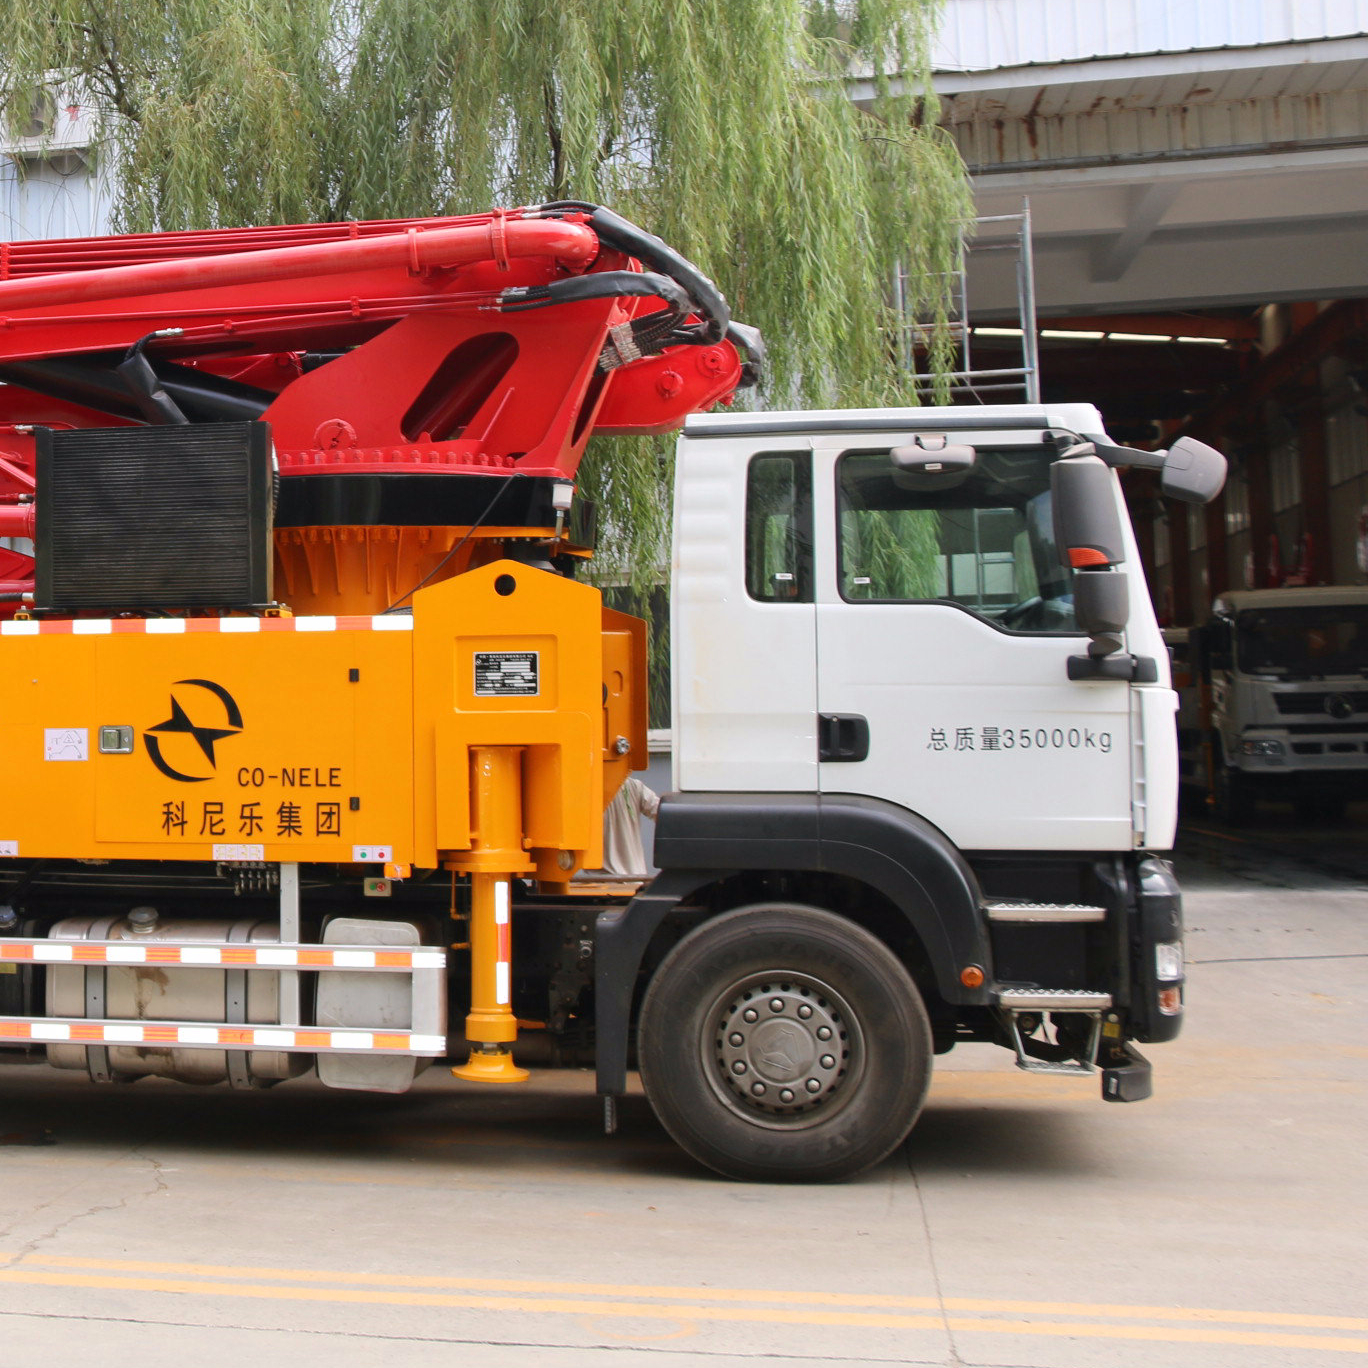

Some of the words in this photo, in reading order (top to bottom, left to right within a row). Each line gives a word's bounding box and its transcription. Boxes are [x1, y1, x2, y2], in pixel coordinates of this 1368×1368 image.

[927, 726, 1112, 753] 总质量35000kg
[237, 767, 342, 788] CO-NELE
[161, 801, 341, 837] 科尼乐集团
